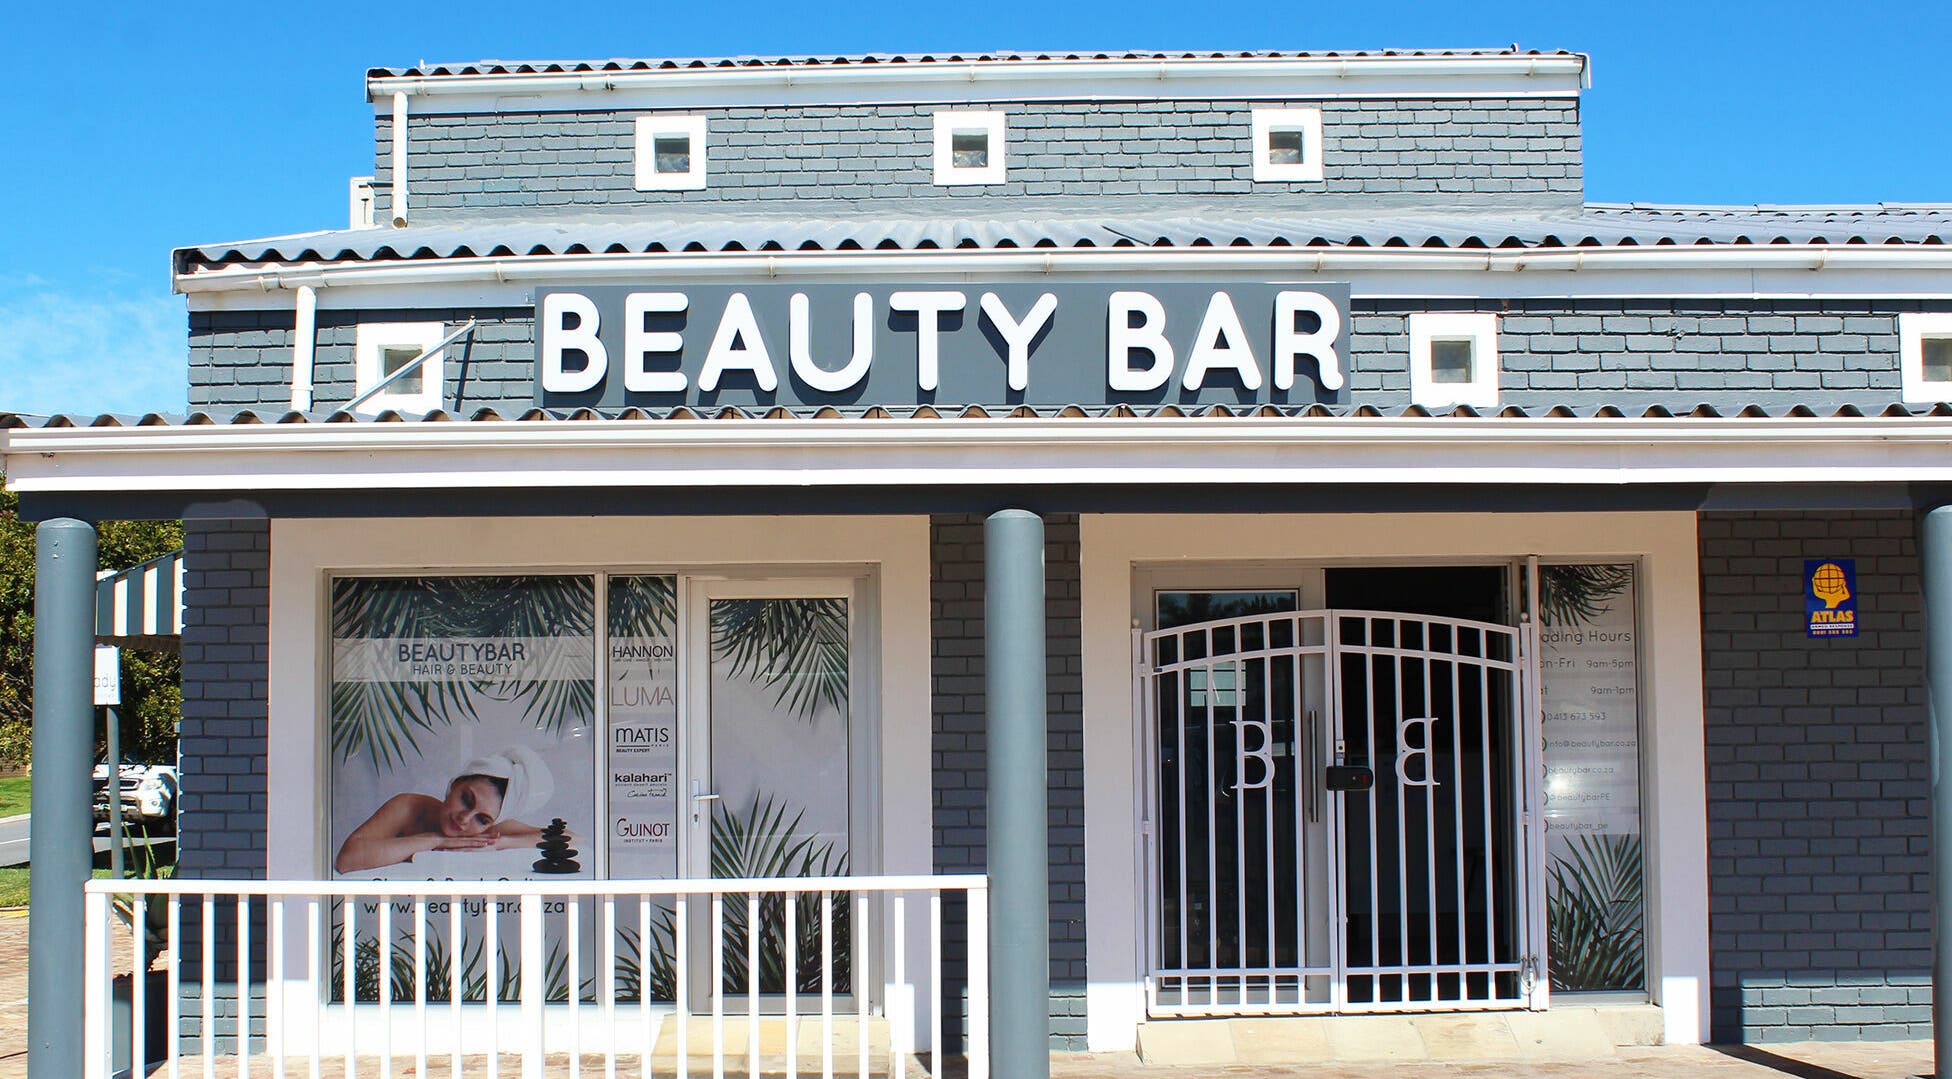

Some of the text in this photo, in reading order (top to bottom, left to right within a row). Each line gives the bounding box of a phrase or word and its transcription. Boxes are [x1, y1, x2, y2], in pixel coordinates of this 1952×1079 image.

[542, 290, 1344, 393] BEAUTY BAR
[1811, 610, 1854, 623] ATLAS
[1541, 630, 1632, 645] ading Hours
[399, 642, 525, 662] BEAUTYBAR
[612, 645, 673, 658] HANNON
[413, 663, 513, 675] HAIR & BEAUTY
[1586, 659, 1634, 670] 9am-5pm
[611, 686, 674, 707] LUMA
[1590, 685, 1635, 696] 9am-1pm
